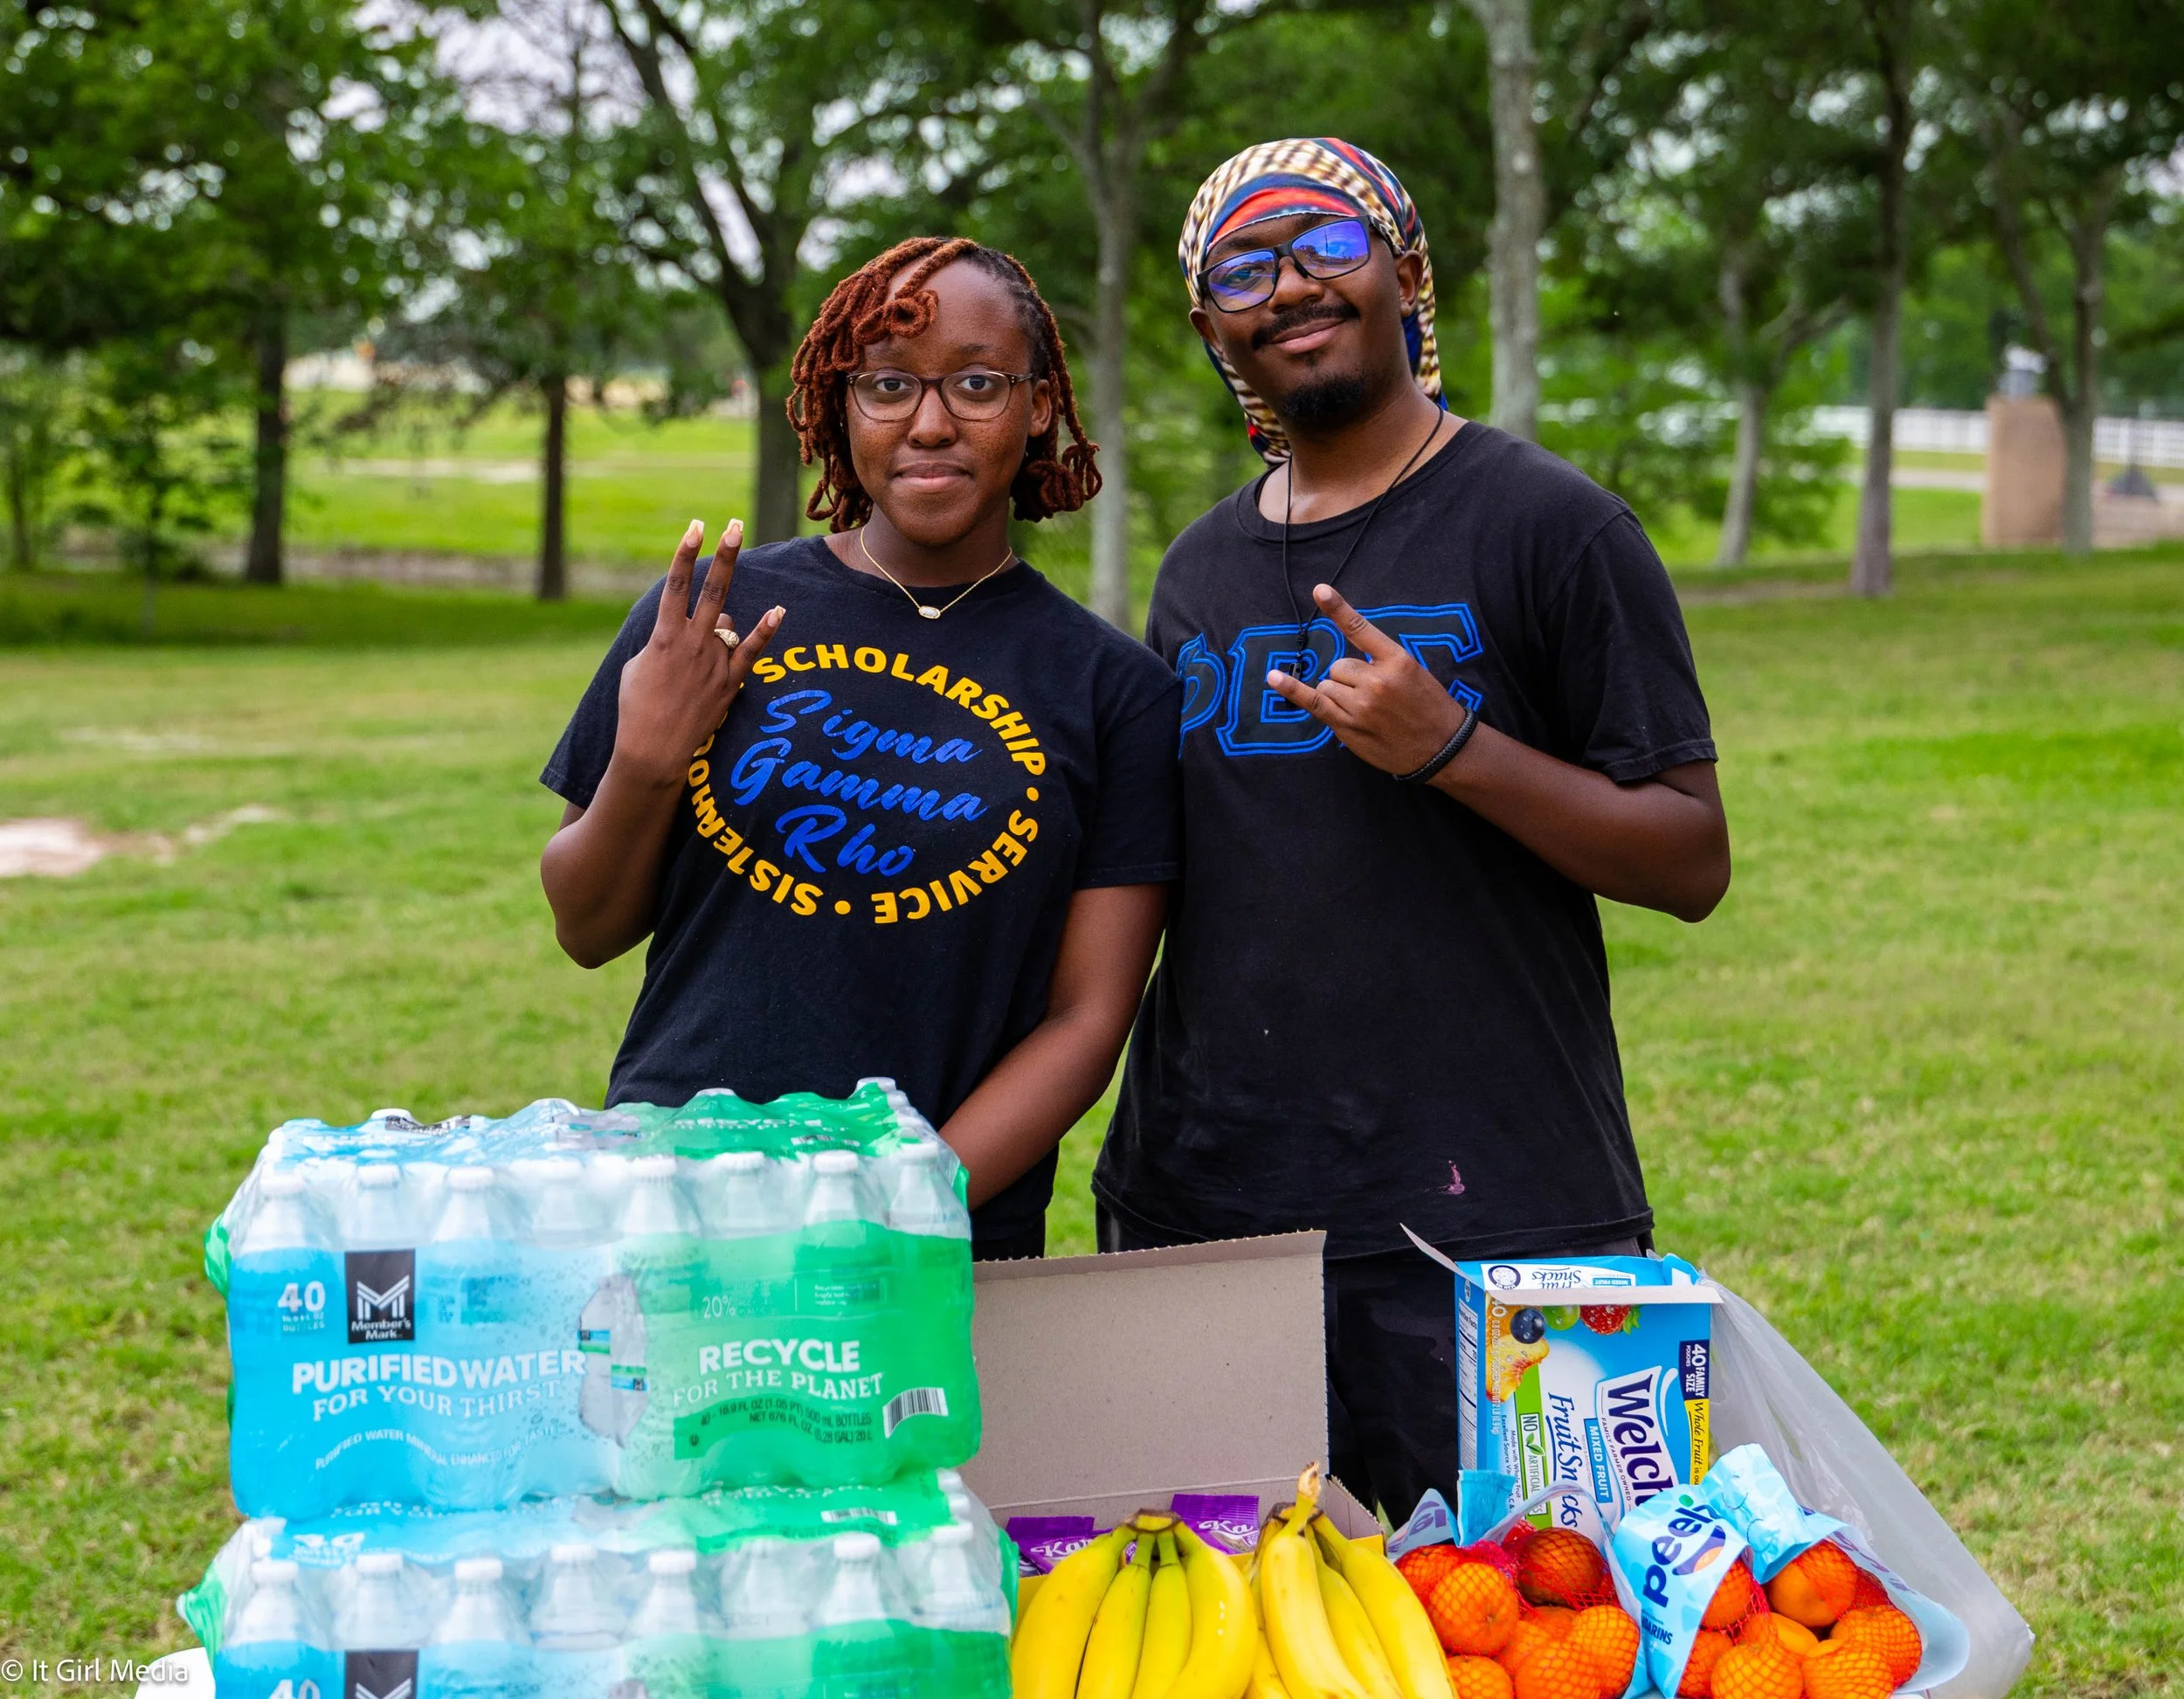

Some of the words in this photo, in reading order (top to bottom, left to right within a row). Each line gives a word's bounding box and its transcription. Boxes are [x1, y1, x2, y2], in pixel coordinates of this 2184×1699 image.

[752, 643, 1047, 777] SCHOLARSHIP
[759, 689, 984, 765] Sigma
[730, 737, 989, 823] Gamma
[687, 732, 824, 916] SISTERHO
[775, 804, 916, 878] Rho
[870, 809, 1041, 924] SERVICE
[1531, 1269, 1582, 1284] Snacks
[277, 1281, 326, 1314] 40
[702, 1295, 736, 1319] 20%
[351, 1316, 411, 1332] Member's
[365, 1330, 398, 1341] Mark
[293, 1354, 456, 1394] PURIFIED
[457, 1350, 587, 1389] WATER
[700, 1338, 860, 1375] RECYCLE
[1691, 1343, 1707, 1366] 40
[673, 1379, 718, 1408] FOR
[726, 1368, 783, 1390] THE
[791, 1371, 882, 1401] PLANET
[1685, 1373, 1696, 1392] SIZE
[1695, 1366, 1705, 1397] FAMILY
[313, 1386, 368, 1422] FOR
[378, 1385, 453, 1418] YOUR
[460, 1378, 562, 1420] THIRST
[719, 1402, 736, 1416] 16.9
[738, 1401, 747, 1412] FL
[750, 1399, 763, 1410] OZ
[805, 1408, 820, 1424] 500
[835, 1412, 872, 1427] BOTTLES
[750, 1412, 766, 1424] NET
[788, 1414, 799, 1428] FL
[801, 1420, 813, 1433] OZ
[1523, 1416, 1538, 1432] NO
[1547, 1392, 1582, 1453] Fruit
[1694, 1402, 1705, 1436] Whole
[315, 1433, 363, 1470] PURIFIED
[365, 1428, 404, 1441] WATER
[405, 1432, 447, 1466] MINERAL
[502, 1440, 522, 1459] FOR
[1589, 1426, 1603, 1462] MIXED
[1601, 1418, 1612, 1445] FAMILY
[1609, 1445, 1623, 1474] FARMER
[1621, 1475, 1632, 1502] OWNED
[1694, 1438, 1704, 1465] Fruit
[1528, 1455, 1540, 1492] ARTIFICIAL
[1557, 1453, 1583, 1528] Sncks
[1595, 1465, 1609, 1498] FRUIT
